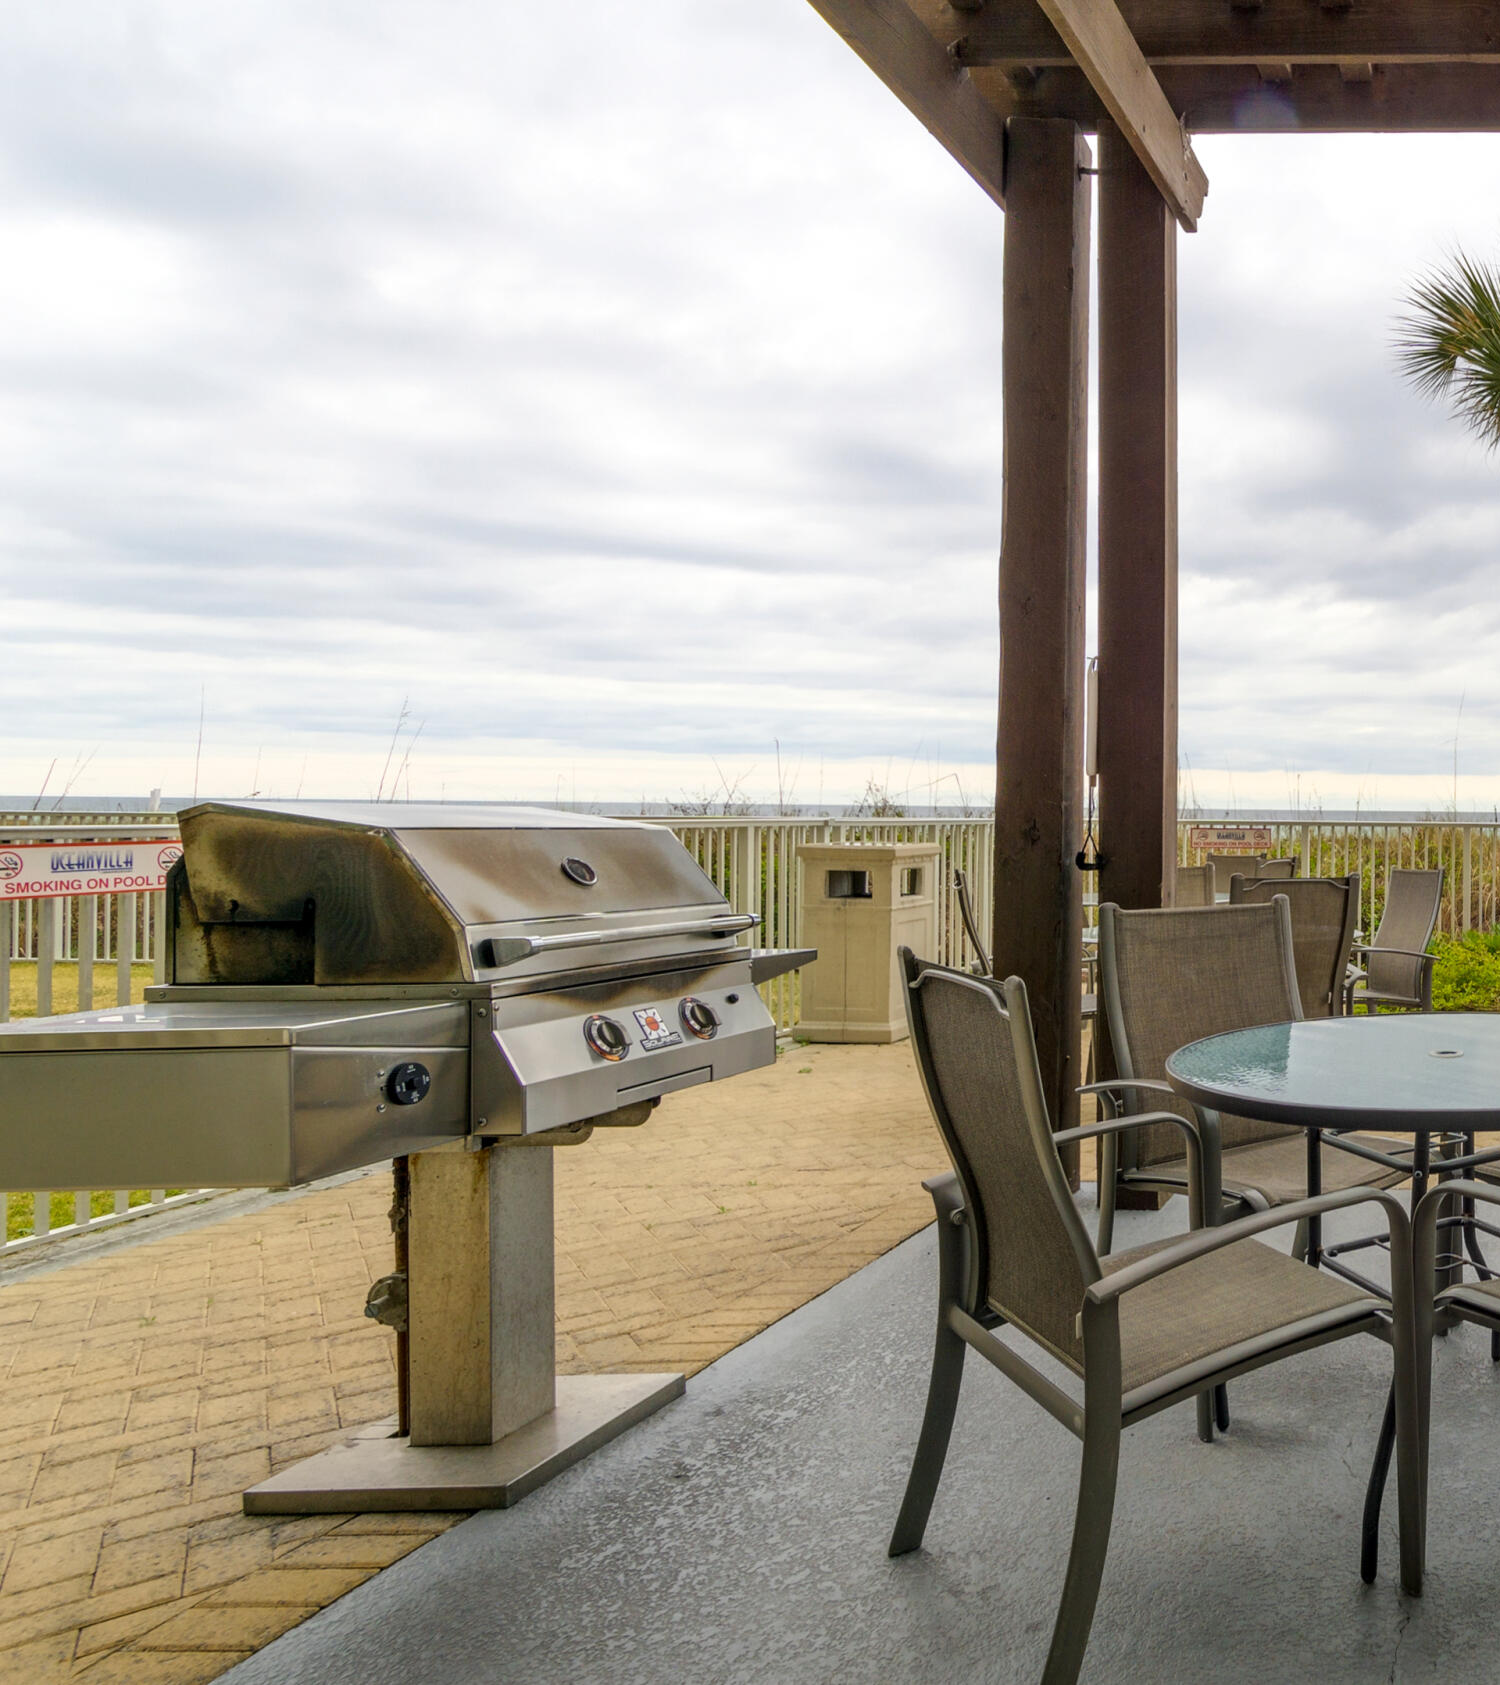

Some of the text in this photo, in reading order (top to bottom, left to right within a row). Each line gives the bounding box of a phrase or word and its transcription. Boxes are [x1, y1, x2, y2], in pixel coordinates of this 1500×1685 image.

[51, 850, 133, 872] OCEANVILLA
[5, 879, 82, 894] SMOKING
[87, 878, 109, 889] ON
[114, 876, 153, 888] POOL
